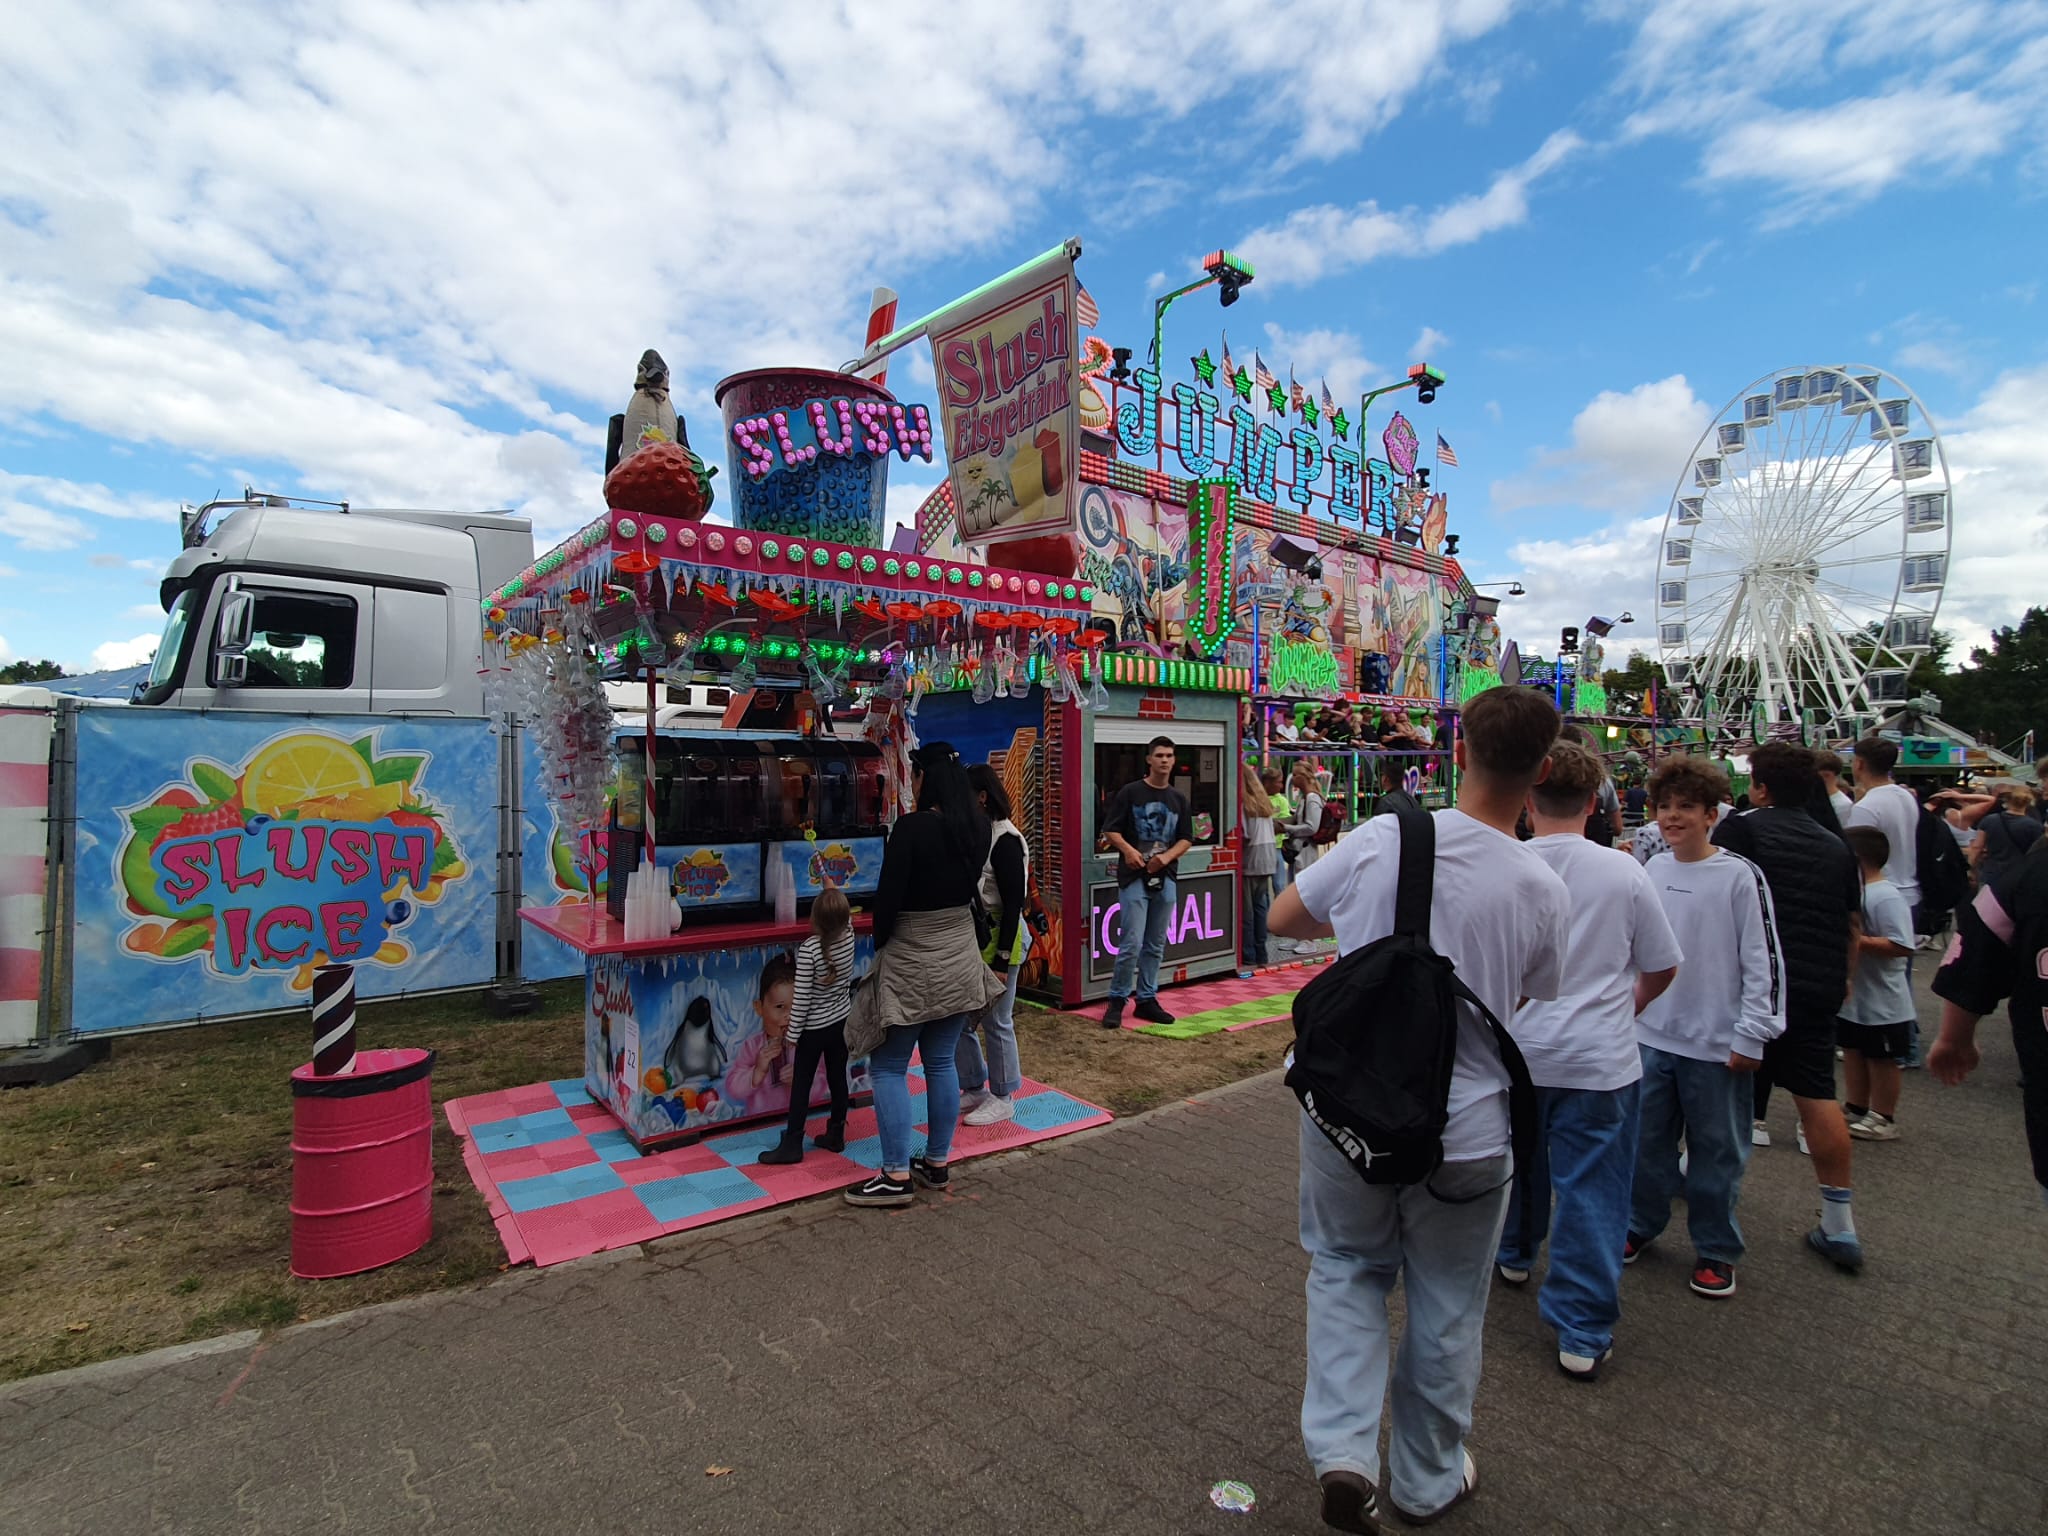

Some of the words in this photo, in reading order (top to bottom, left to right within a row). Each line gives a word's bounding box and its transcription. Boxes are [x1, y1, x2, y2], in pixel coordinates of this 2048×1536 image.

[943, 294, 1069, 408] Slush
[733, 399, 932, 482] SLUSH
[952, 361, 1072, 463] Eisgetränk
[1115, 367, 1398, 531] JUMPER
[161, 826, 426, 905] SLUSH
[222, 900, 368, 969] ICE
[592, 966, 634, 1018] Slush
[627, 1049, 636, 1069] 22
[1305, 1090, 1362, 1160] PUMA
